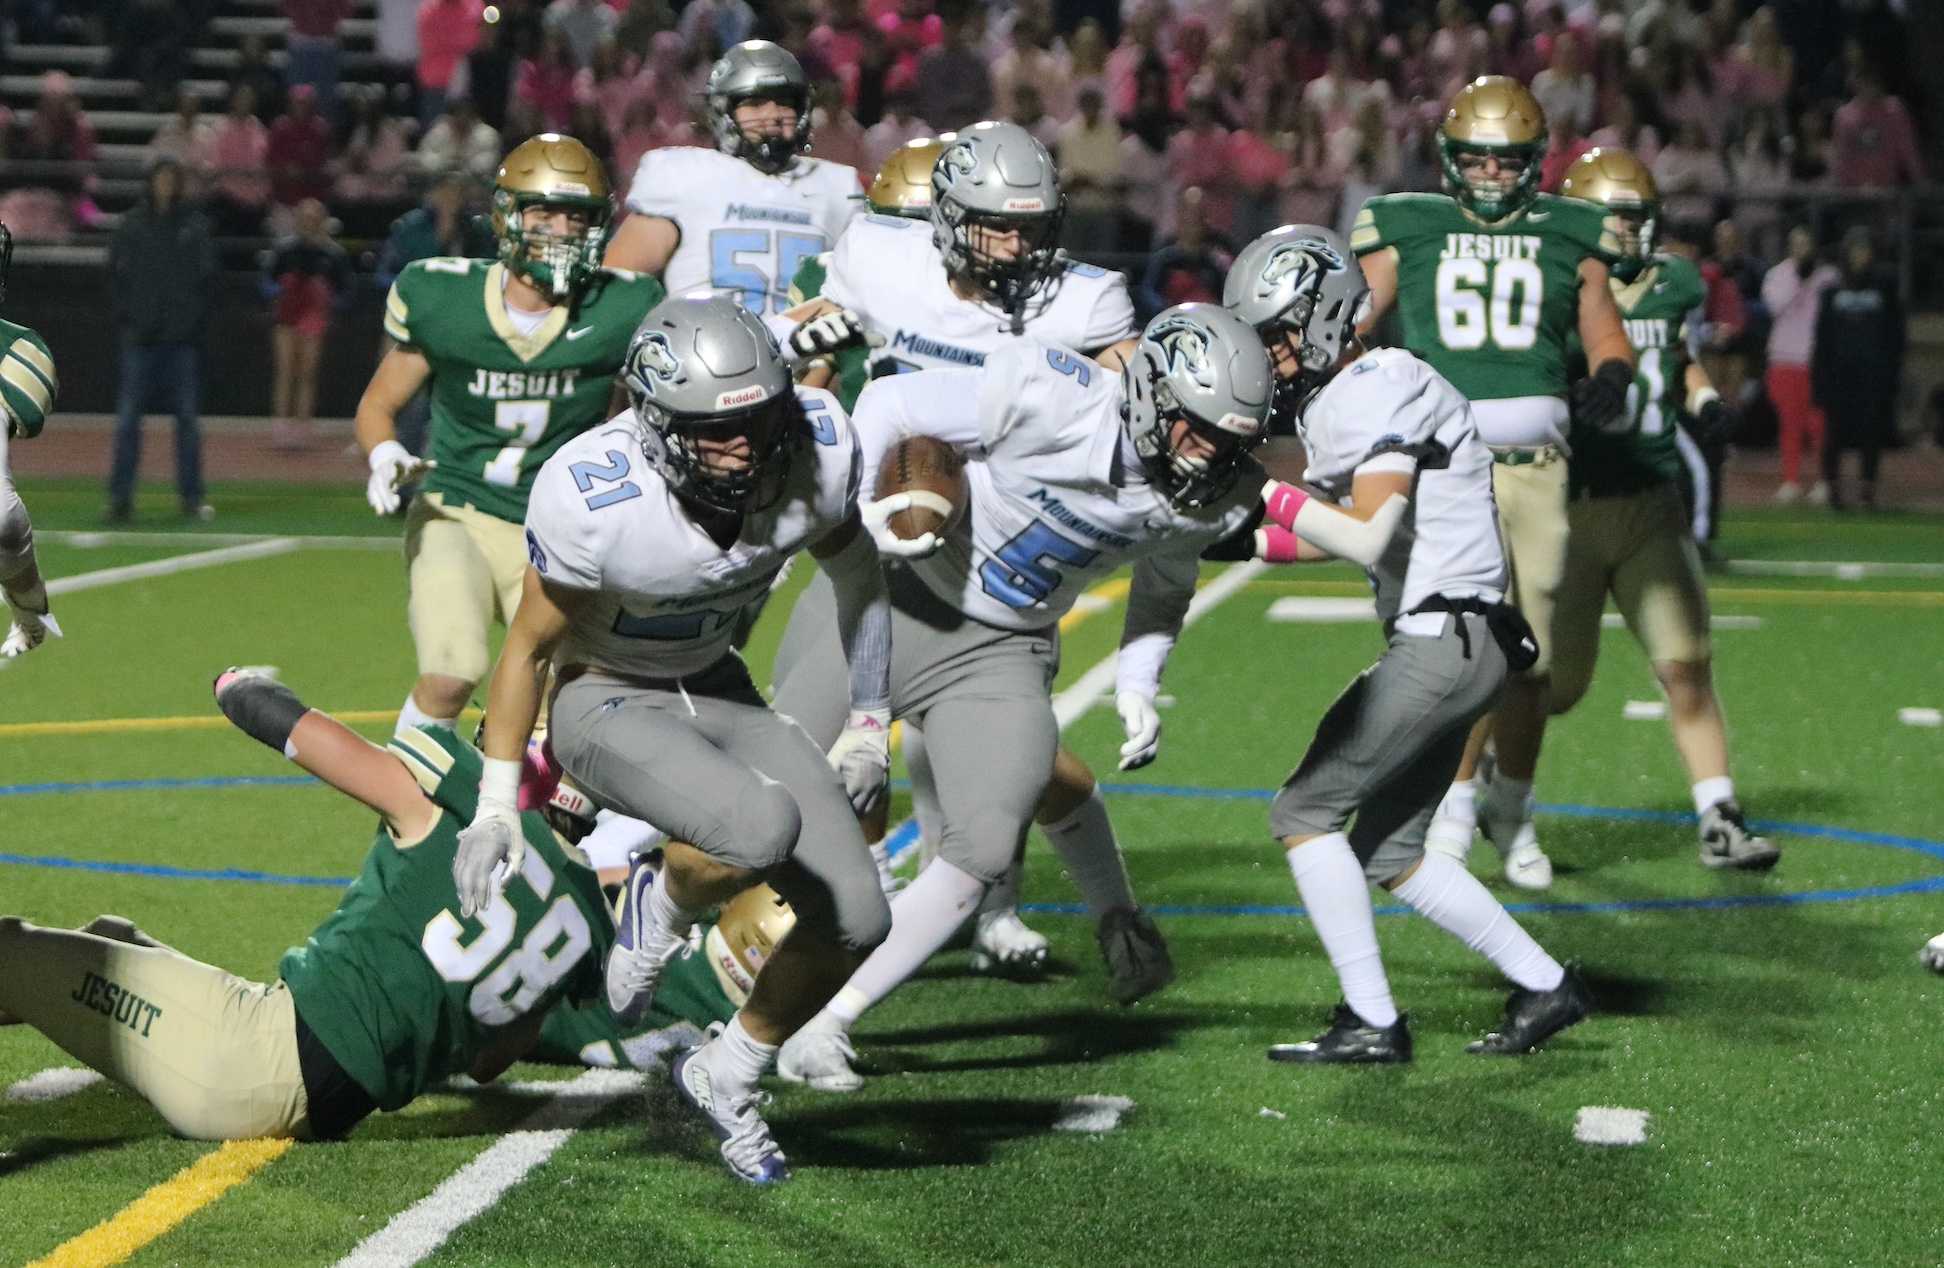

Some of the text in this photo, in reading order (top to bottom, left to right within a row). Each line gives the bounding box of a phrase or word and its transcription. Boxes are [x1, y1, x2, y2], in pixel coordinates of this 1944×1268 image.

[1439, 233, 1542, 260] JESUIT
[1435, 257, 1543, 351] 60
[468, 369, 581, 399] JESUIT
[722, 389, 763, 406] Riddell
[483, 400, 551, 488] 7
[568, 449, 642, 511] 21
[979, 516, 1101, 609] 5
[421, 838, 592, 1025] 58
[72, 971, 162, 1038] JESUIT
